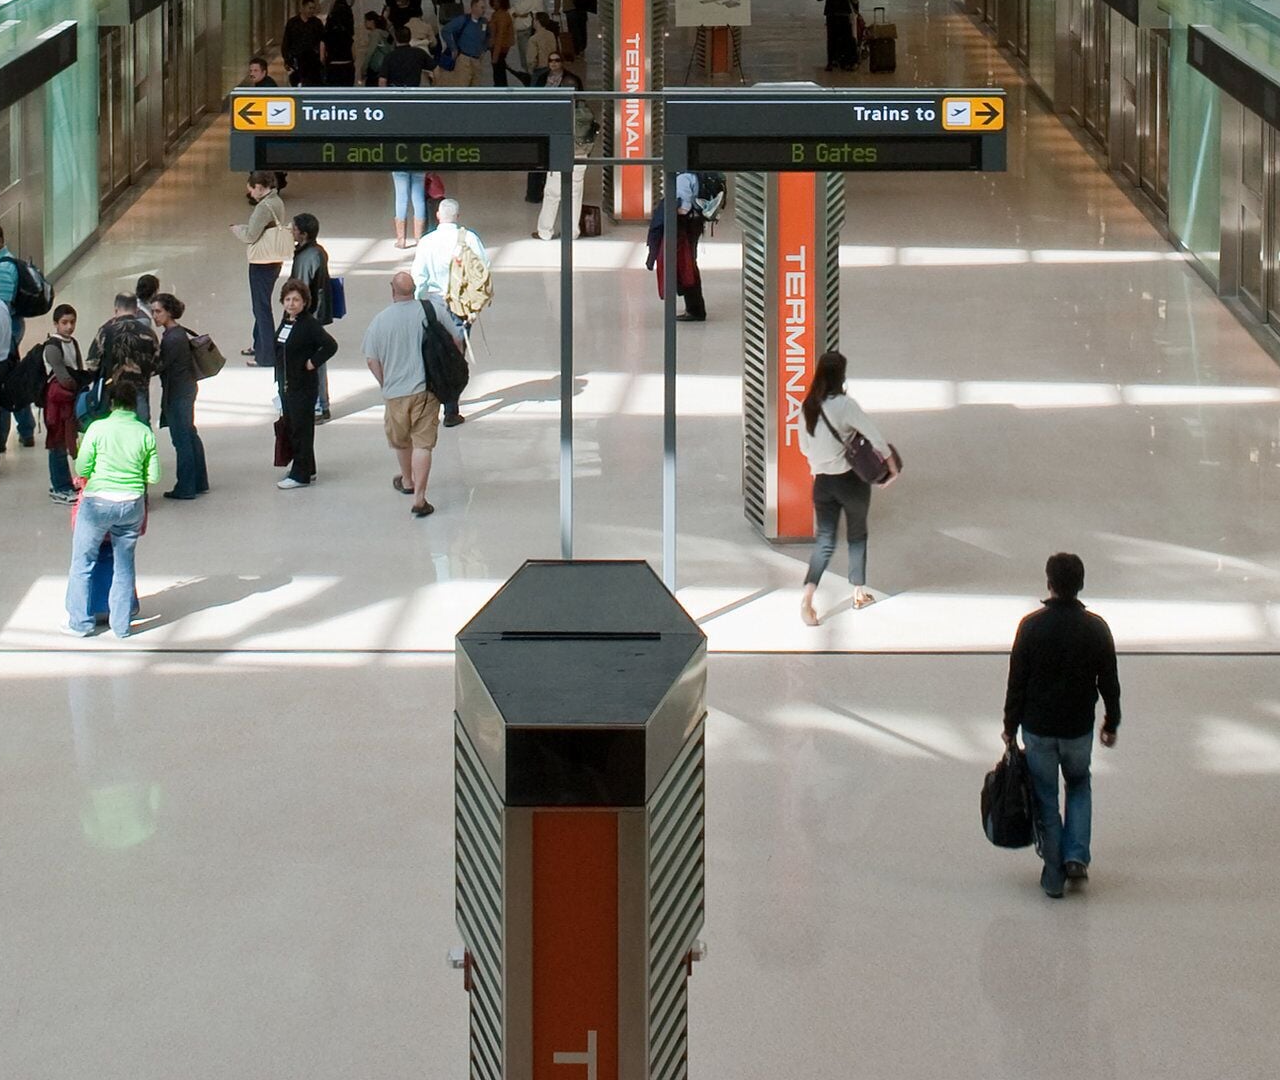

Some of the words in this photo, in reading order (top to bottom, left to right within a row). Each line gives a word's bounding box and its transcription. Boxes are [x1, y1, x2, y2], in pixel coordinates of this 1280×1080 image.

[626, 33, 640, 158] TERMINAL
[302, 106, 358, 121] Trains
[363, 106, 384, 121] to
[853, 106, 910, 121] Trains
[915, 106, 936, 121] to
[322, 142, 335, 163] A
[347, 142, 384, 163] and
[395, 142, 408, 163] C
[420, 142, 481, 163] Gates
[791, 142, 804, 163] B
[815, 142, 878, 163] Gates
[784, 245, 806, 447] TERMINAL
